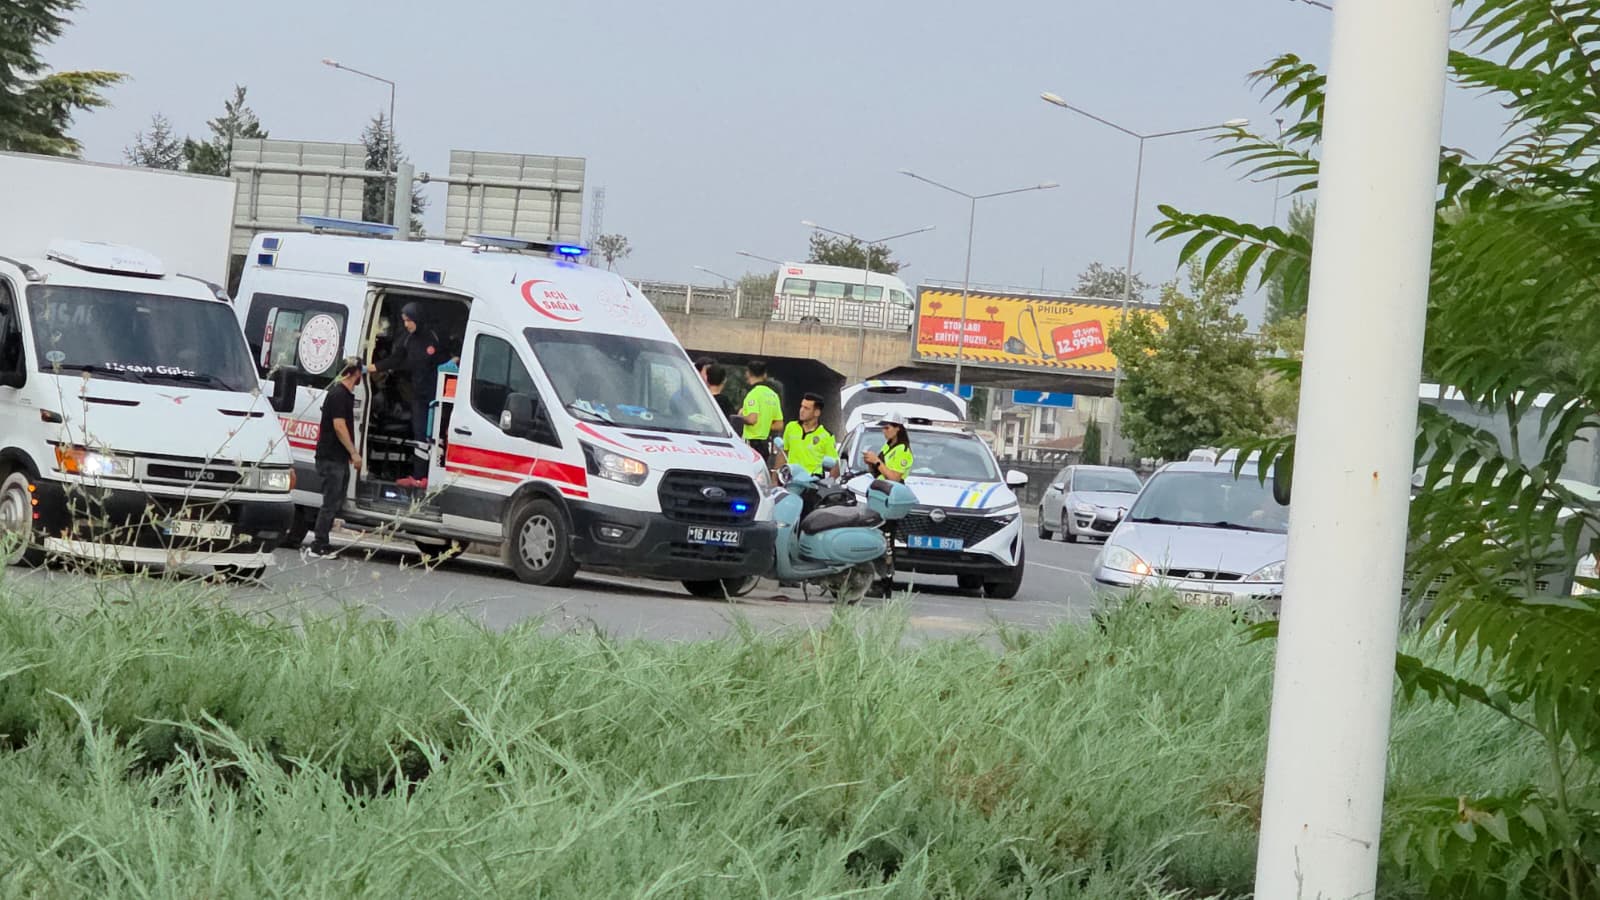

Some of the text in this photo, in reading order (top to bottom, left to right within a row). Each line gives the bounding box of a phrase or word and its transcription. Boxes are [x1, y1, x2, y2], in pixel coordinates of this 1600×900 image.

[1037, 304, 1074, 316] PHILIPS
[694, 528, 738, 543] 16 ALS 222
